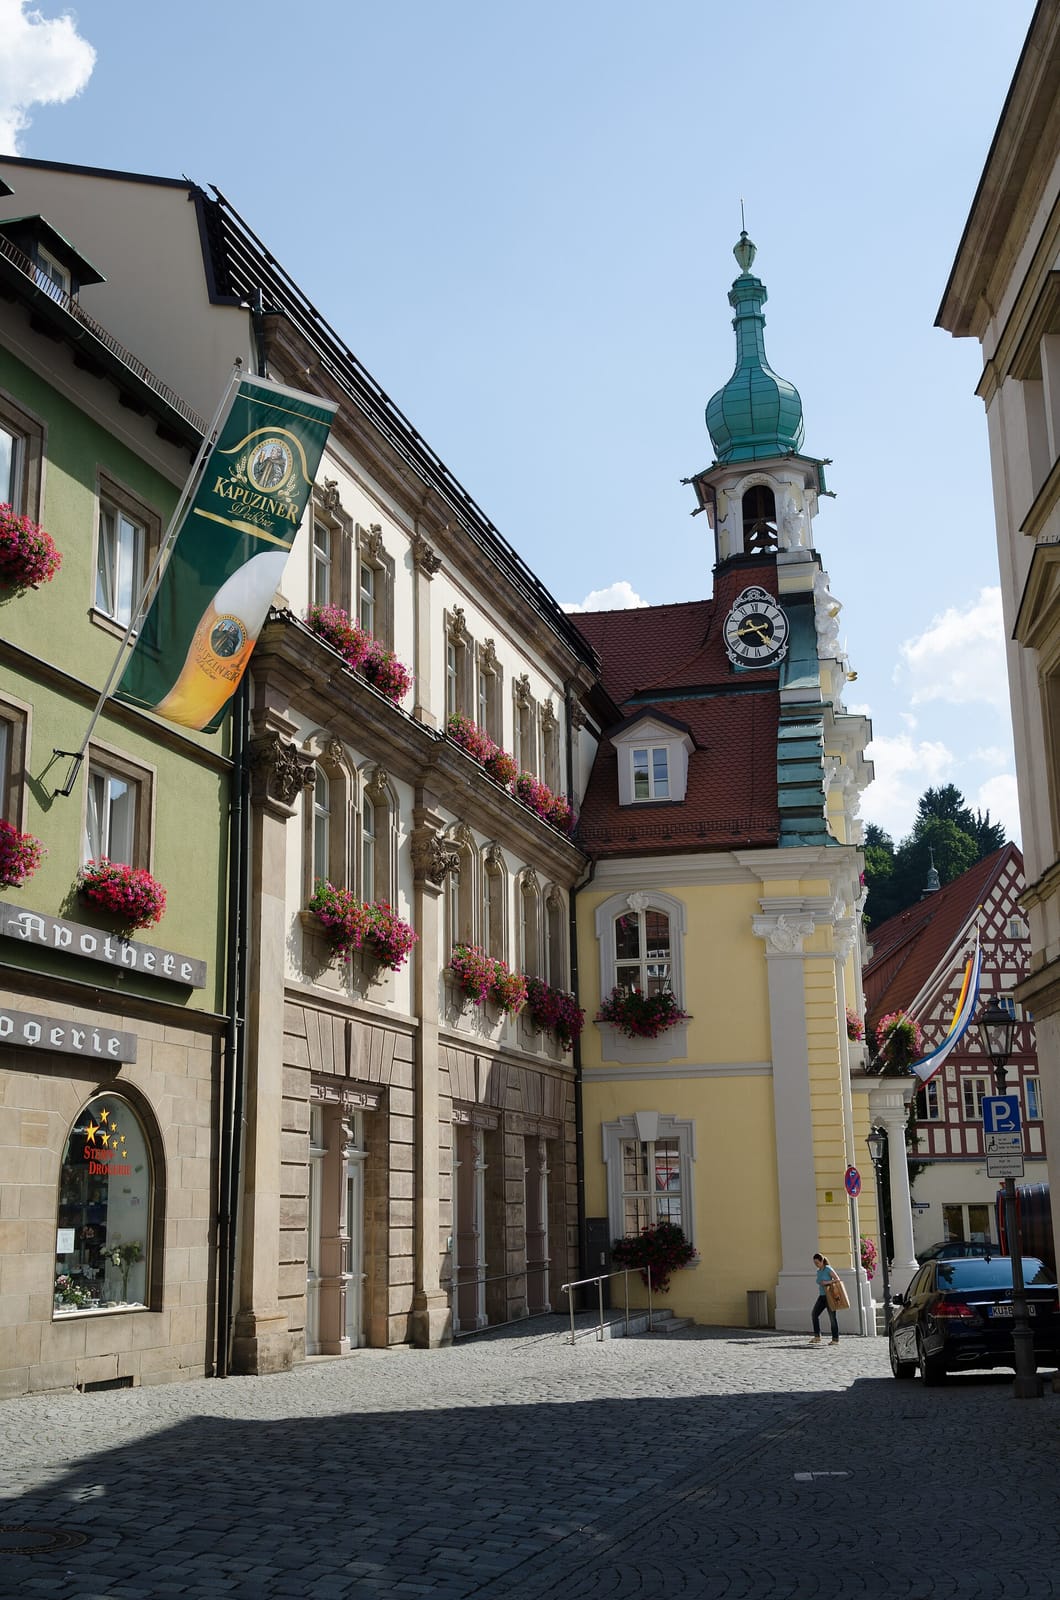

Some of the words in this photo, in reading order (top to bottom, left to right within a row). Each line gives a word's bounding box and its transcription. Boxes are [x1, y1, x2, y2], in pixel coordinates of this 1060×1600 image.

[212, 475, 299, 524] KAPUZINER
[8, 912, 194, 981] Apotheke
[990, 1100, 1011, 1132] P
